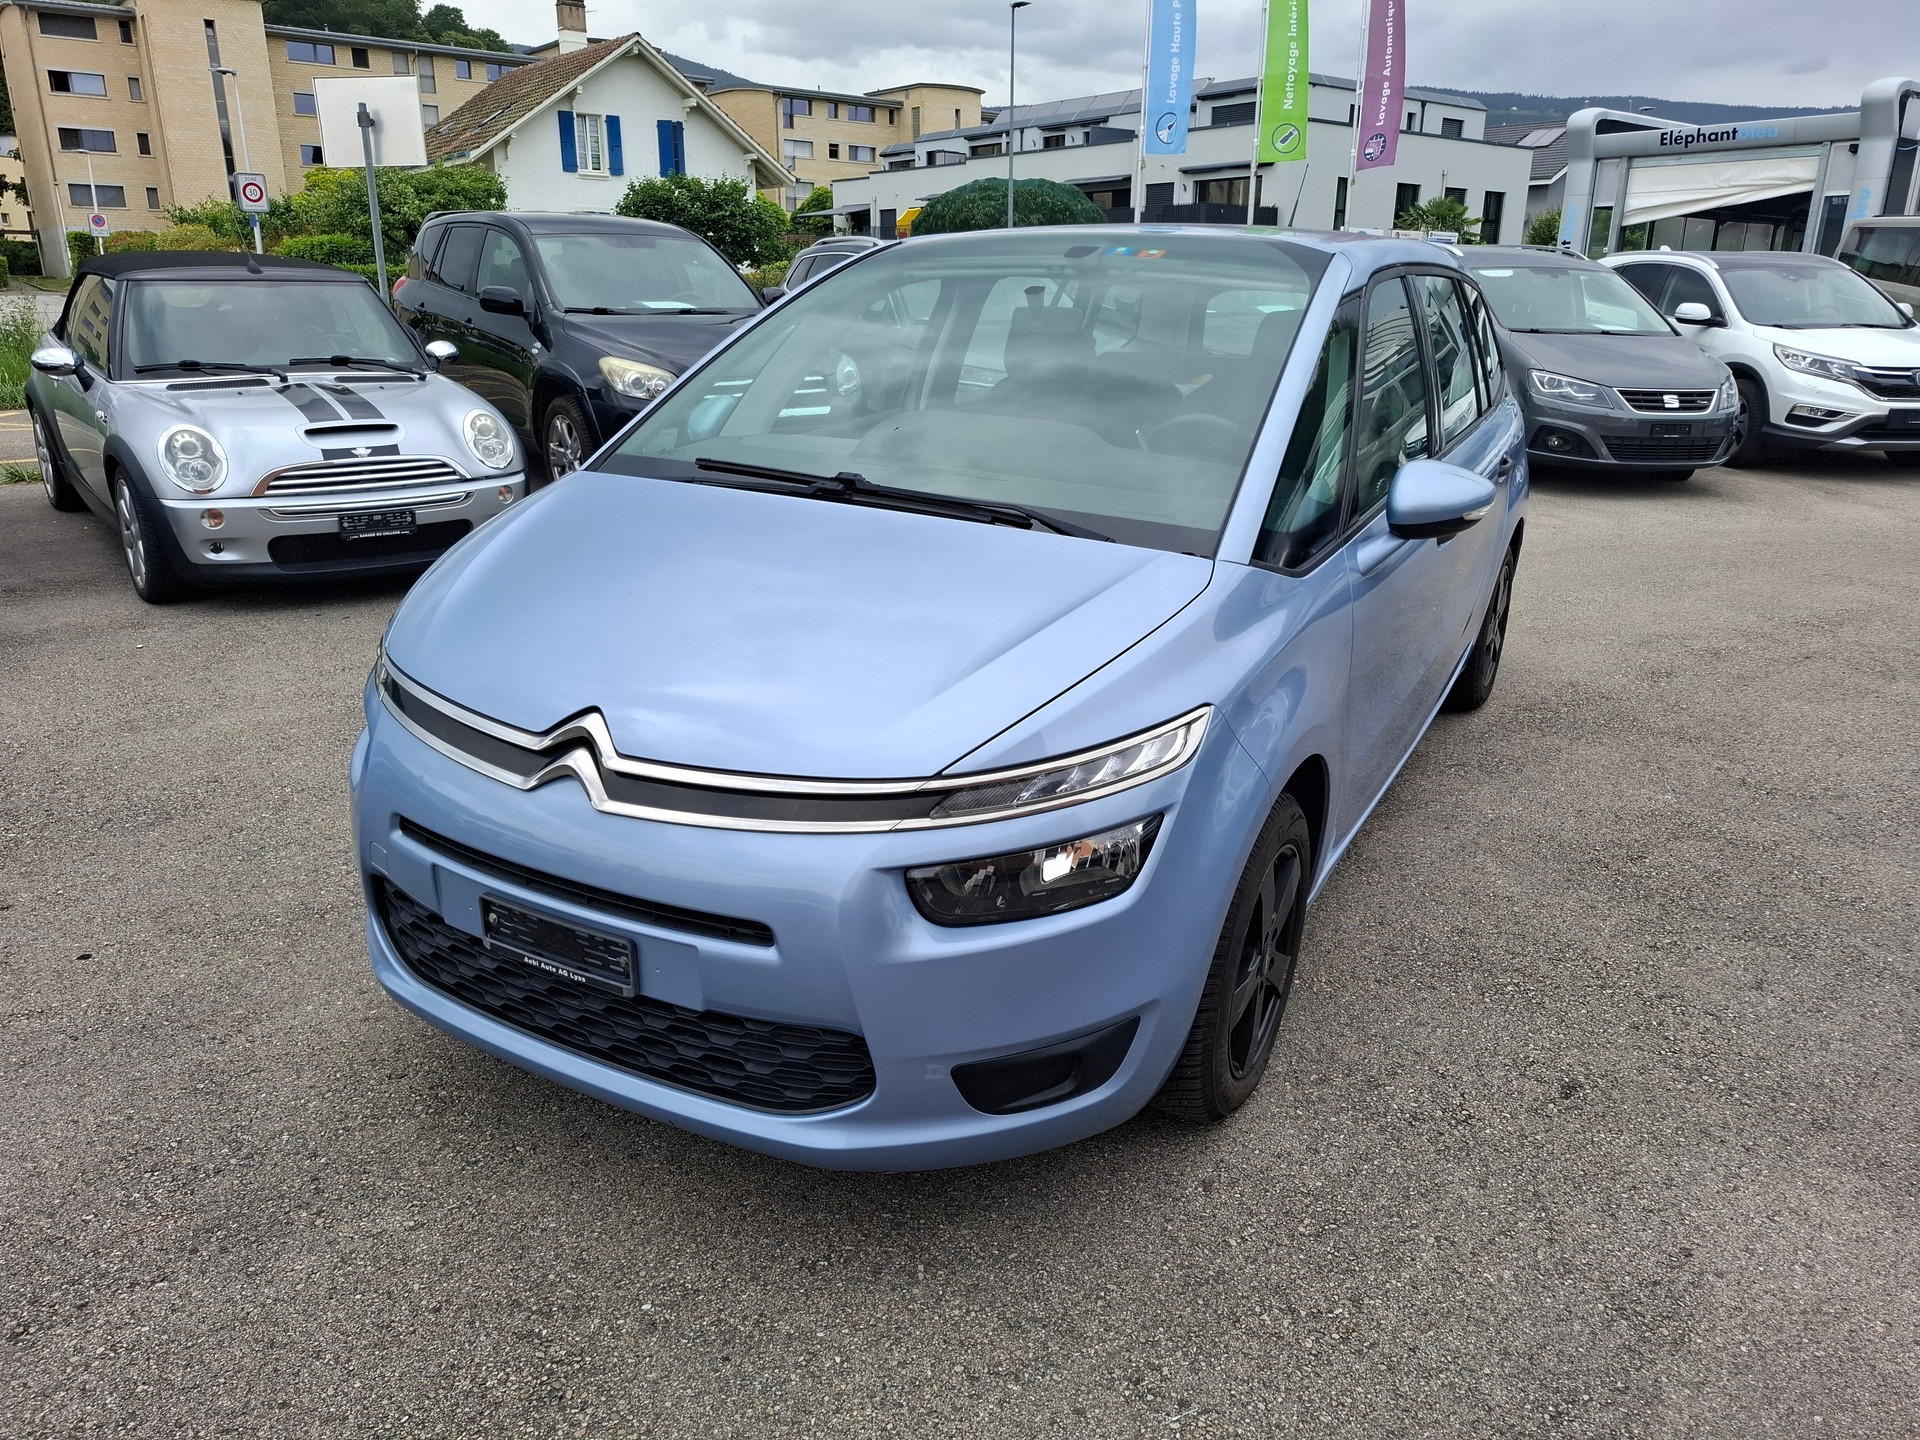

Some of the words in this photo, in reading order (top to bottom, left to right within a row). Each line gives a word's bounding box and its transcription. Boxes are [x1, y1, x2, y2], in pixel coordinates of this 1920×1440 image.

[1170, 12, 1182, 53] Haute
[1287, 0, 1298, 37] Intéri
[1166, 56, 1180, 104] Lavage
[1283, 41, 1299, 110] Nettoyage
[1375, 81, 1391, 126] Lavage
[248, 189, 258, 197] 30
[541, 962, 557, 972] Auto
